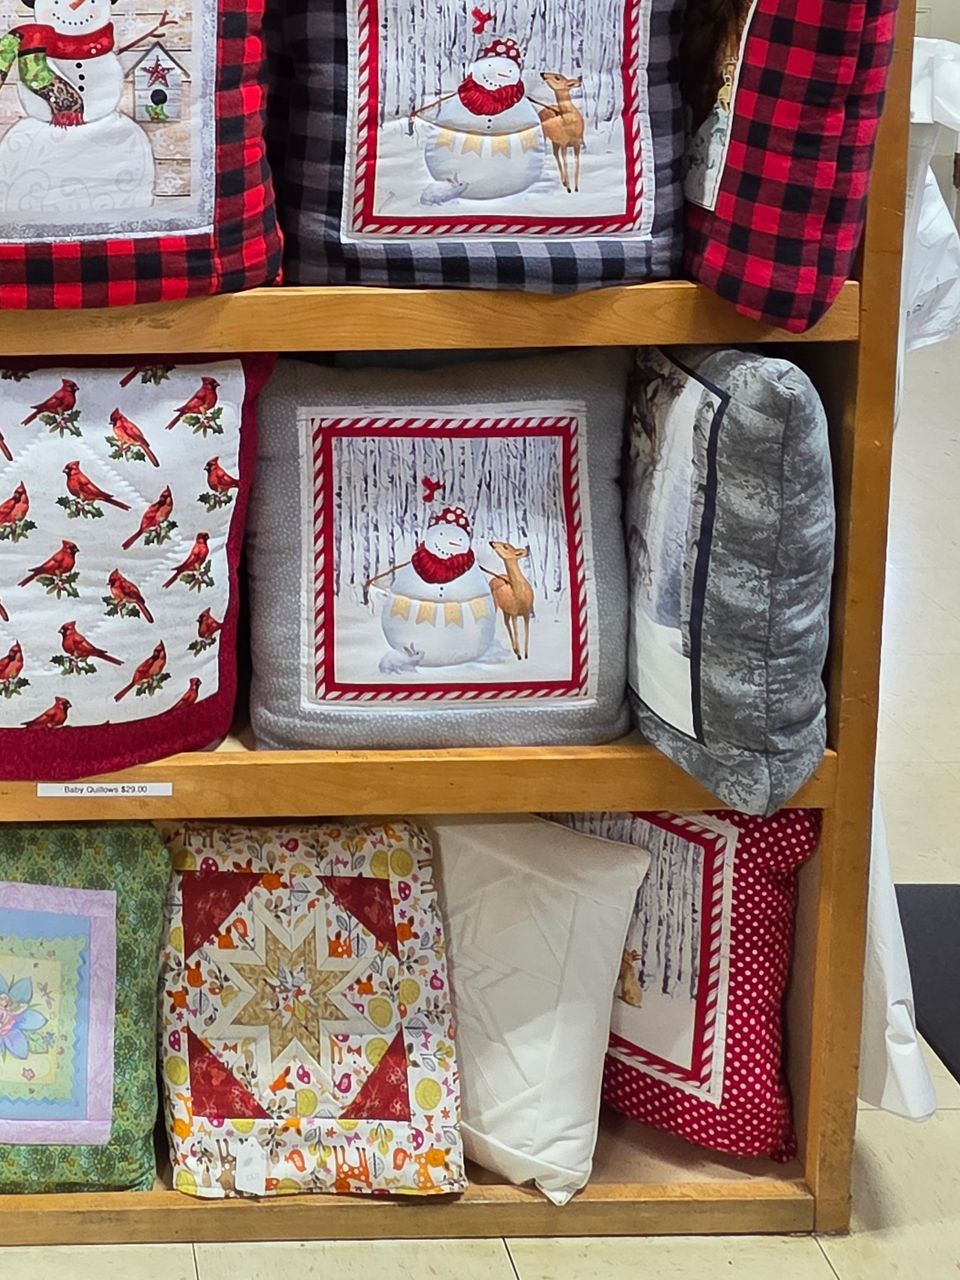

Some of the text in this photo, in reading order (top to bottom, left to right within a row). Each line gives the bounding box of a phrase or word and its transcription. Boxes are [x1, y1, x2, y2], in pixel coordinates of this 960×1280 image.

[64, 785, 148, 794] Baby Quillows $29.00
